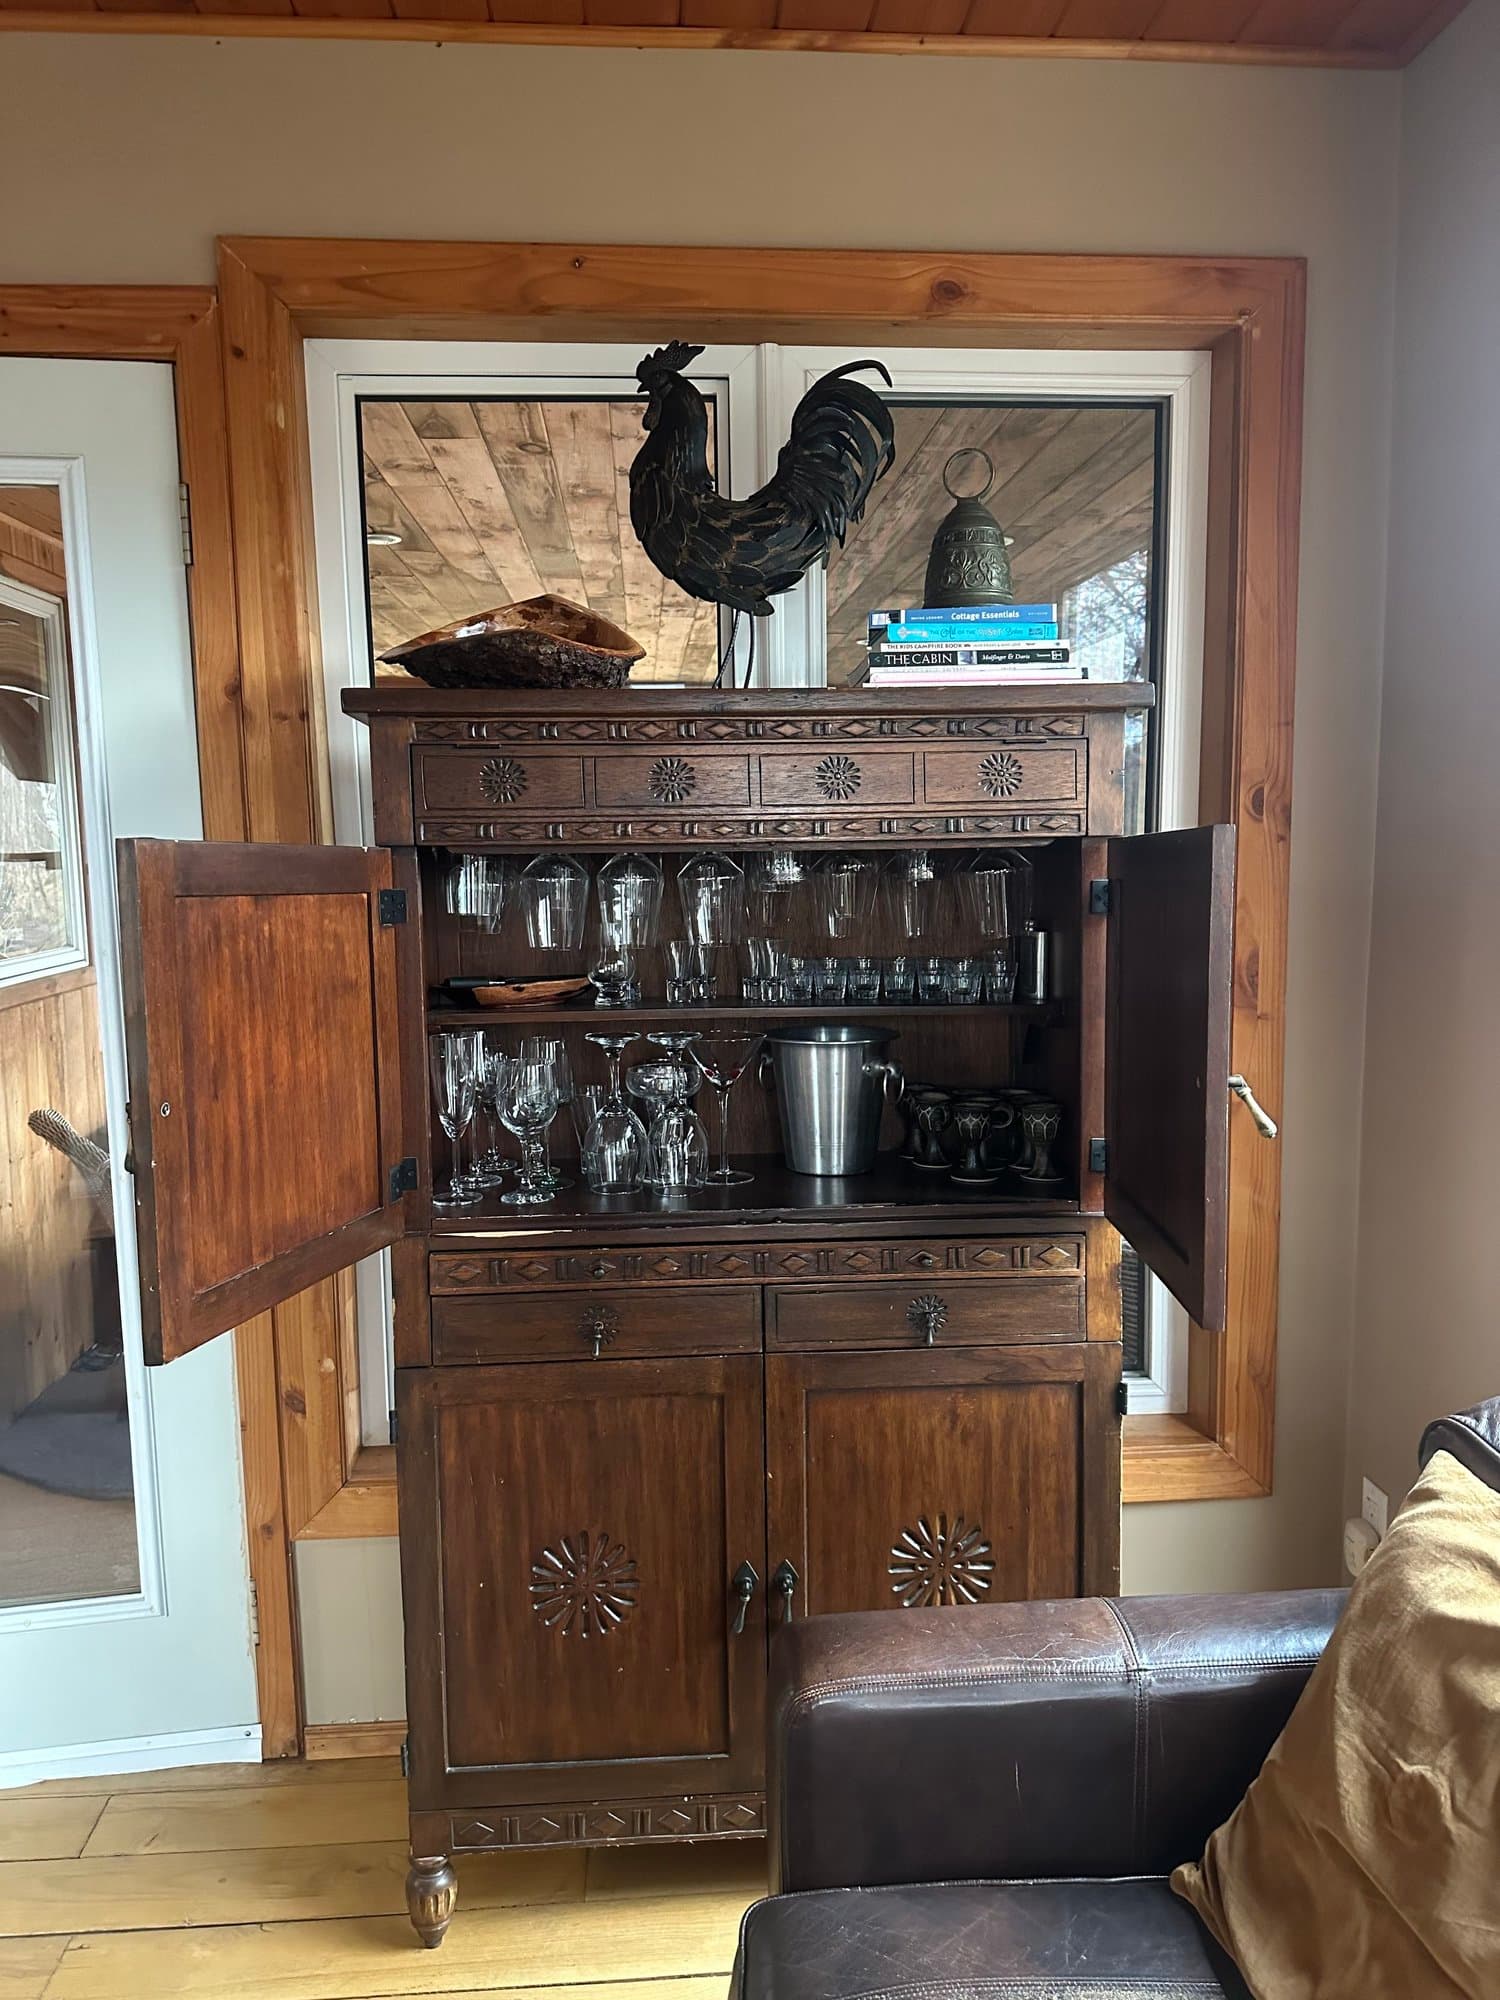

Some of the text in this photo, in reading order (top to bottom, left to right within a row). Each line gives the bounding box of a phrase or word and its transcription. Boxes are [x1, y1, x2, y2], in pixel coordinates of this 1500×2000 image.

[951, 612, 980, 621] Cottage
[981, 610, 1020, 619] Essentials
[884, 653, 952, 665] THE CABIN
